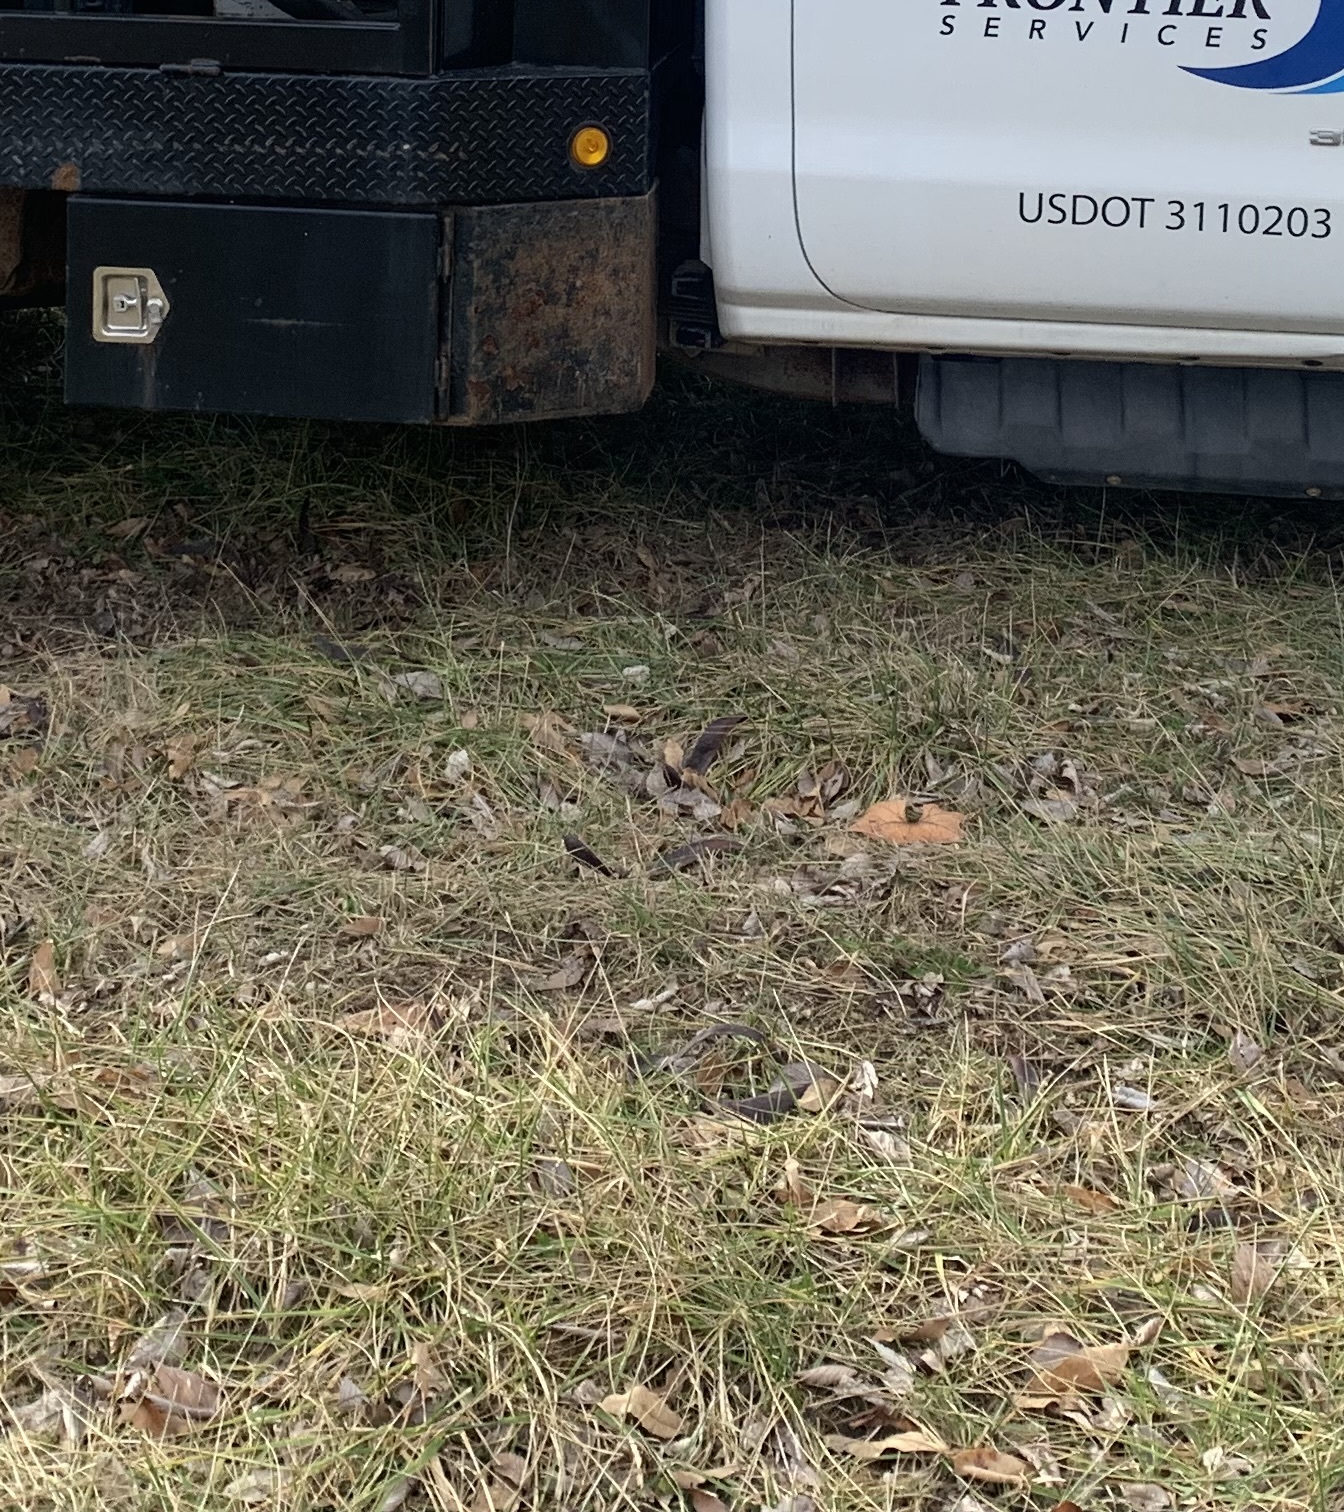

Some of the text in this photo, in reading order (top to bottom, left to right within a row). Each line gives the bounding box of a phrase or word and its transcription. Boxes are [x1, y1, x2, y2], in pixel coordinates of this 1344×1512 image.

[939, 14, 1269, 50] SERVICES
[1019, 192, 1332, 239] USDOT 3110203
